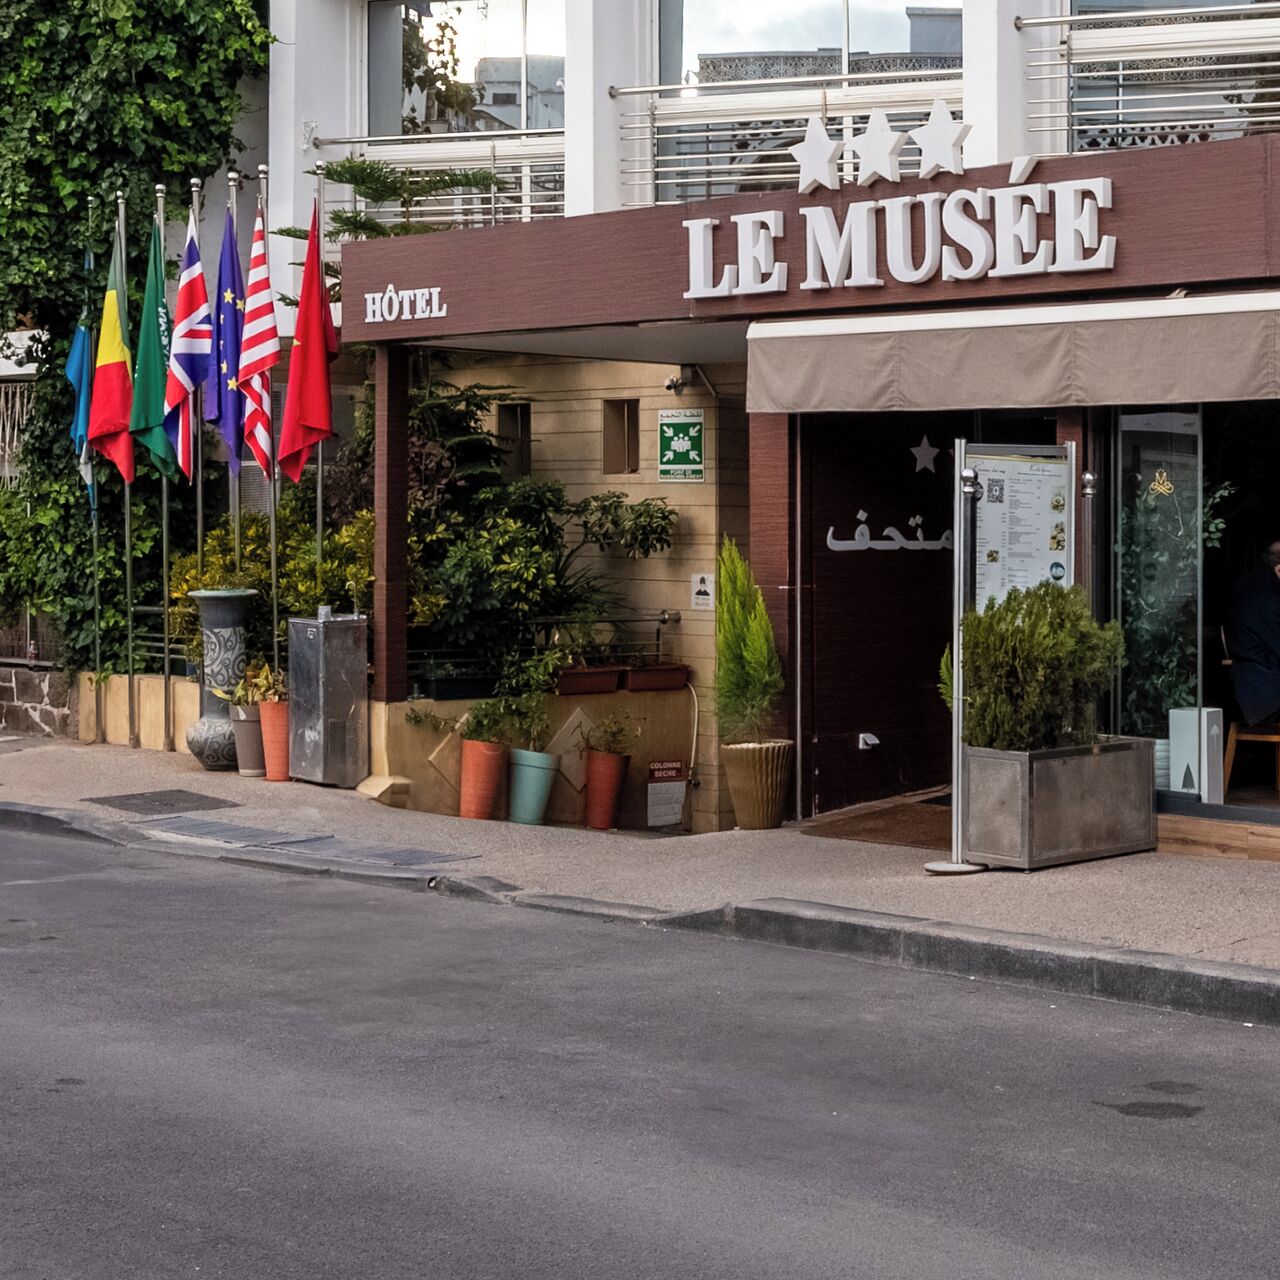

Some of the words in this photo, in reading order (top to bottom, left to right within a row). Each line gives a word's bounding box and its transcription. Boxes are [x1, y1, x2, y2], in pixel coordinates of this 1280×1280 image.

[682, 210, 788, 300] LE
[799, 155, 1117, 290] MUSÉE
[364, 283, 447, 323] HÔTEL
